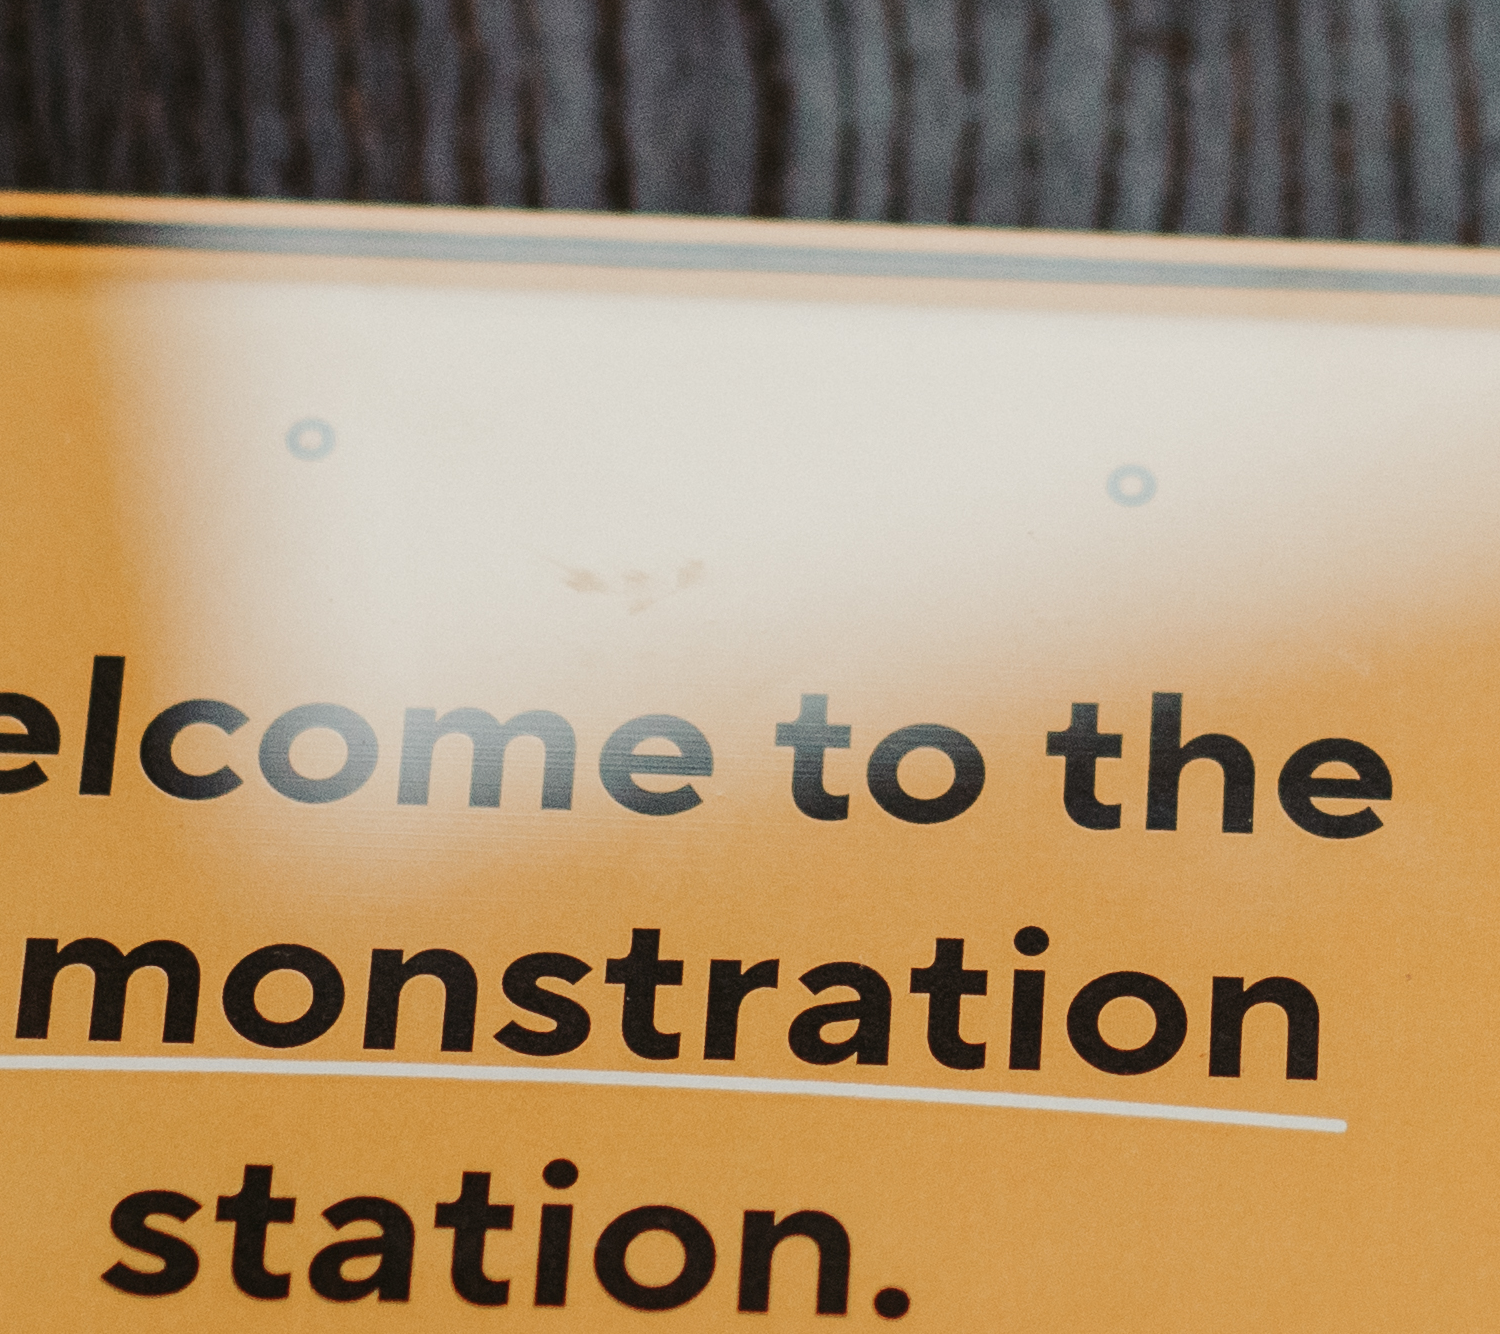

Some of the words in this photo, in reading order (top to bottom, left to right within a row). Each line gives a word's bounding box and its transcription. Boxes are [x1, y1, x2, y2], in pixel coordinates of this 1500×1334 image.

[774, 691, 988, 827] to
[1048, 691, 1396, 841] the
[100, 1157, 912, 1323] station.
